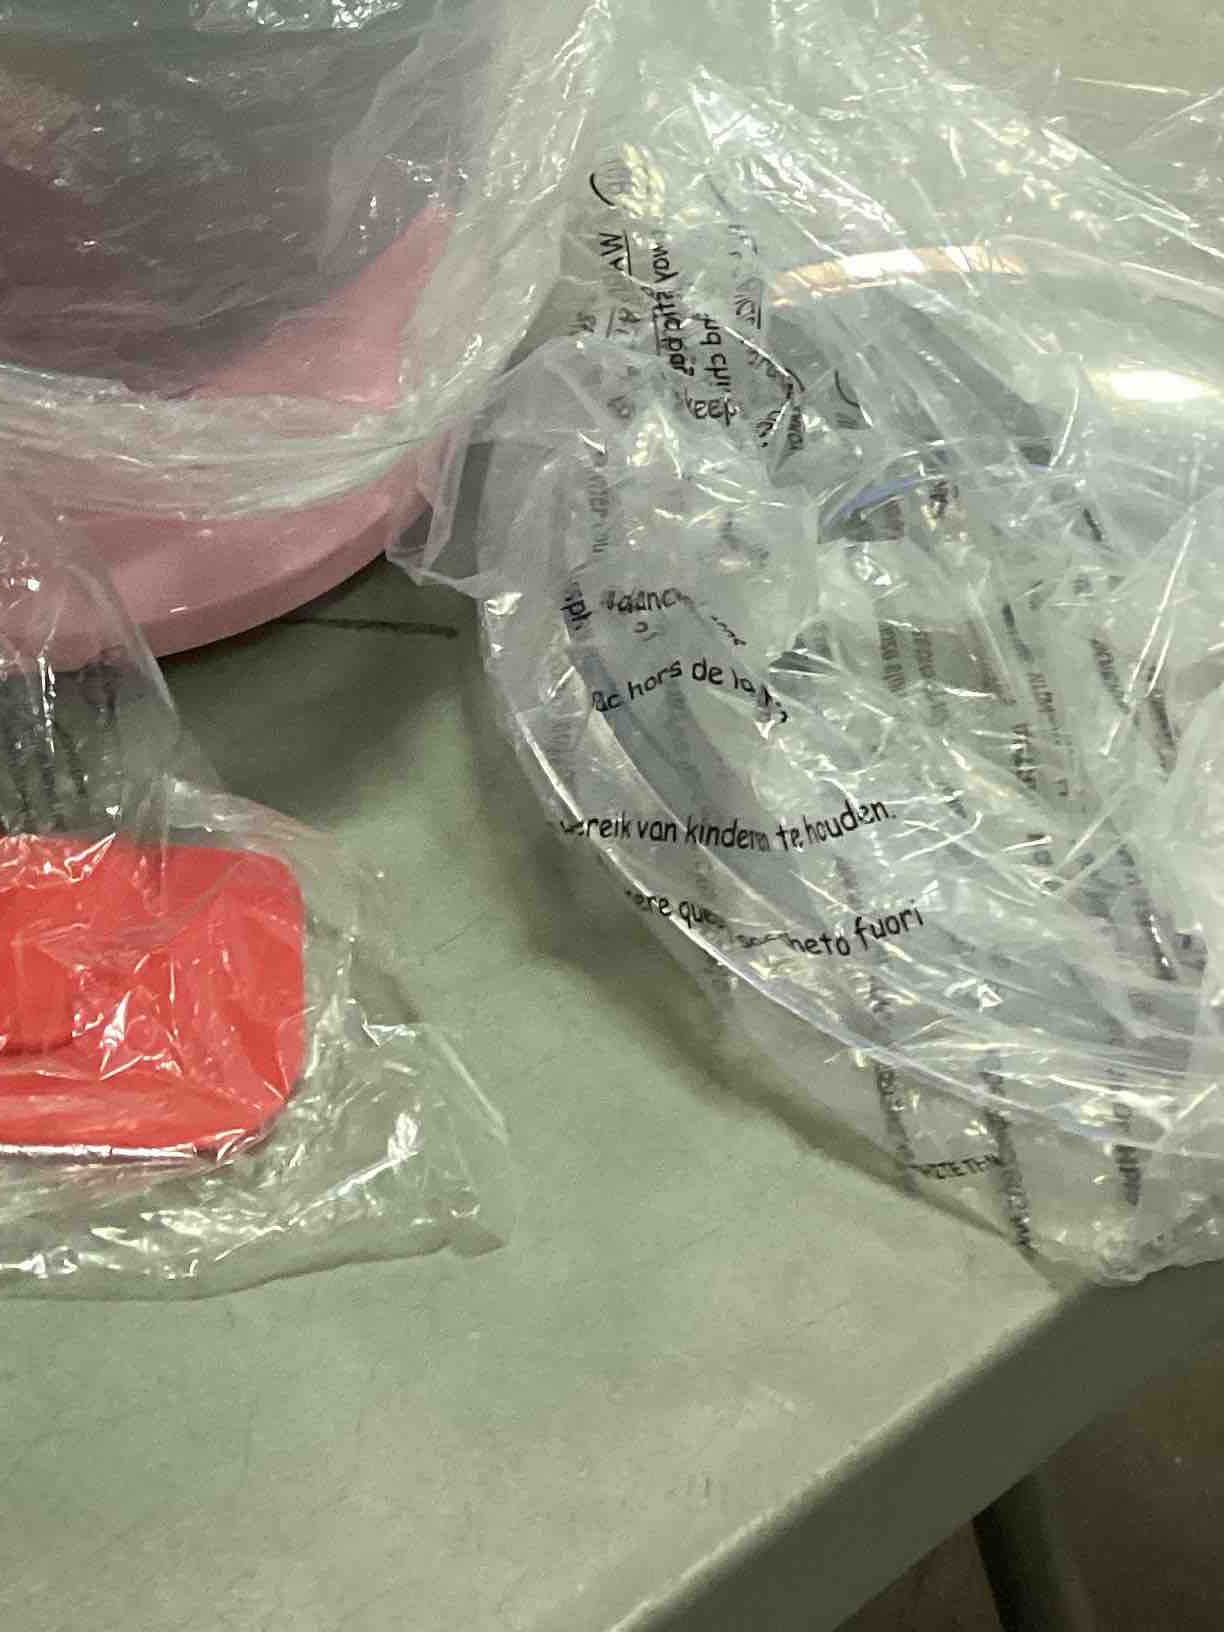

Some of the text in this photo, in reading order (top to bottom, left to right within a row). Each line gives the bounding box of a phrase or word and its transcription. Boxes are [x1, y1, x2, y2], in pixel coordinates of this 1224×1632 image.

[628, 659, 683, 700] hors
[692, 657, 724, 686] de
[638, 818, 677, 843] van
[854, 900, 924, 951] fuori
